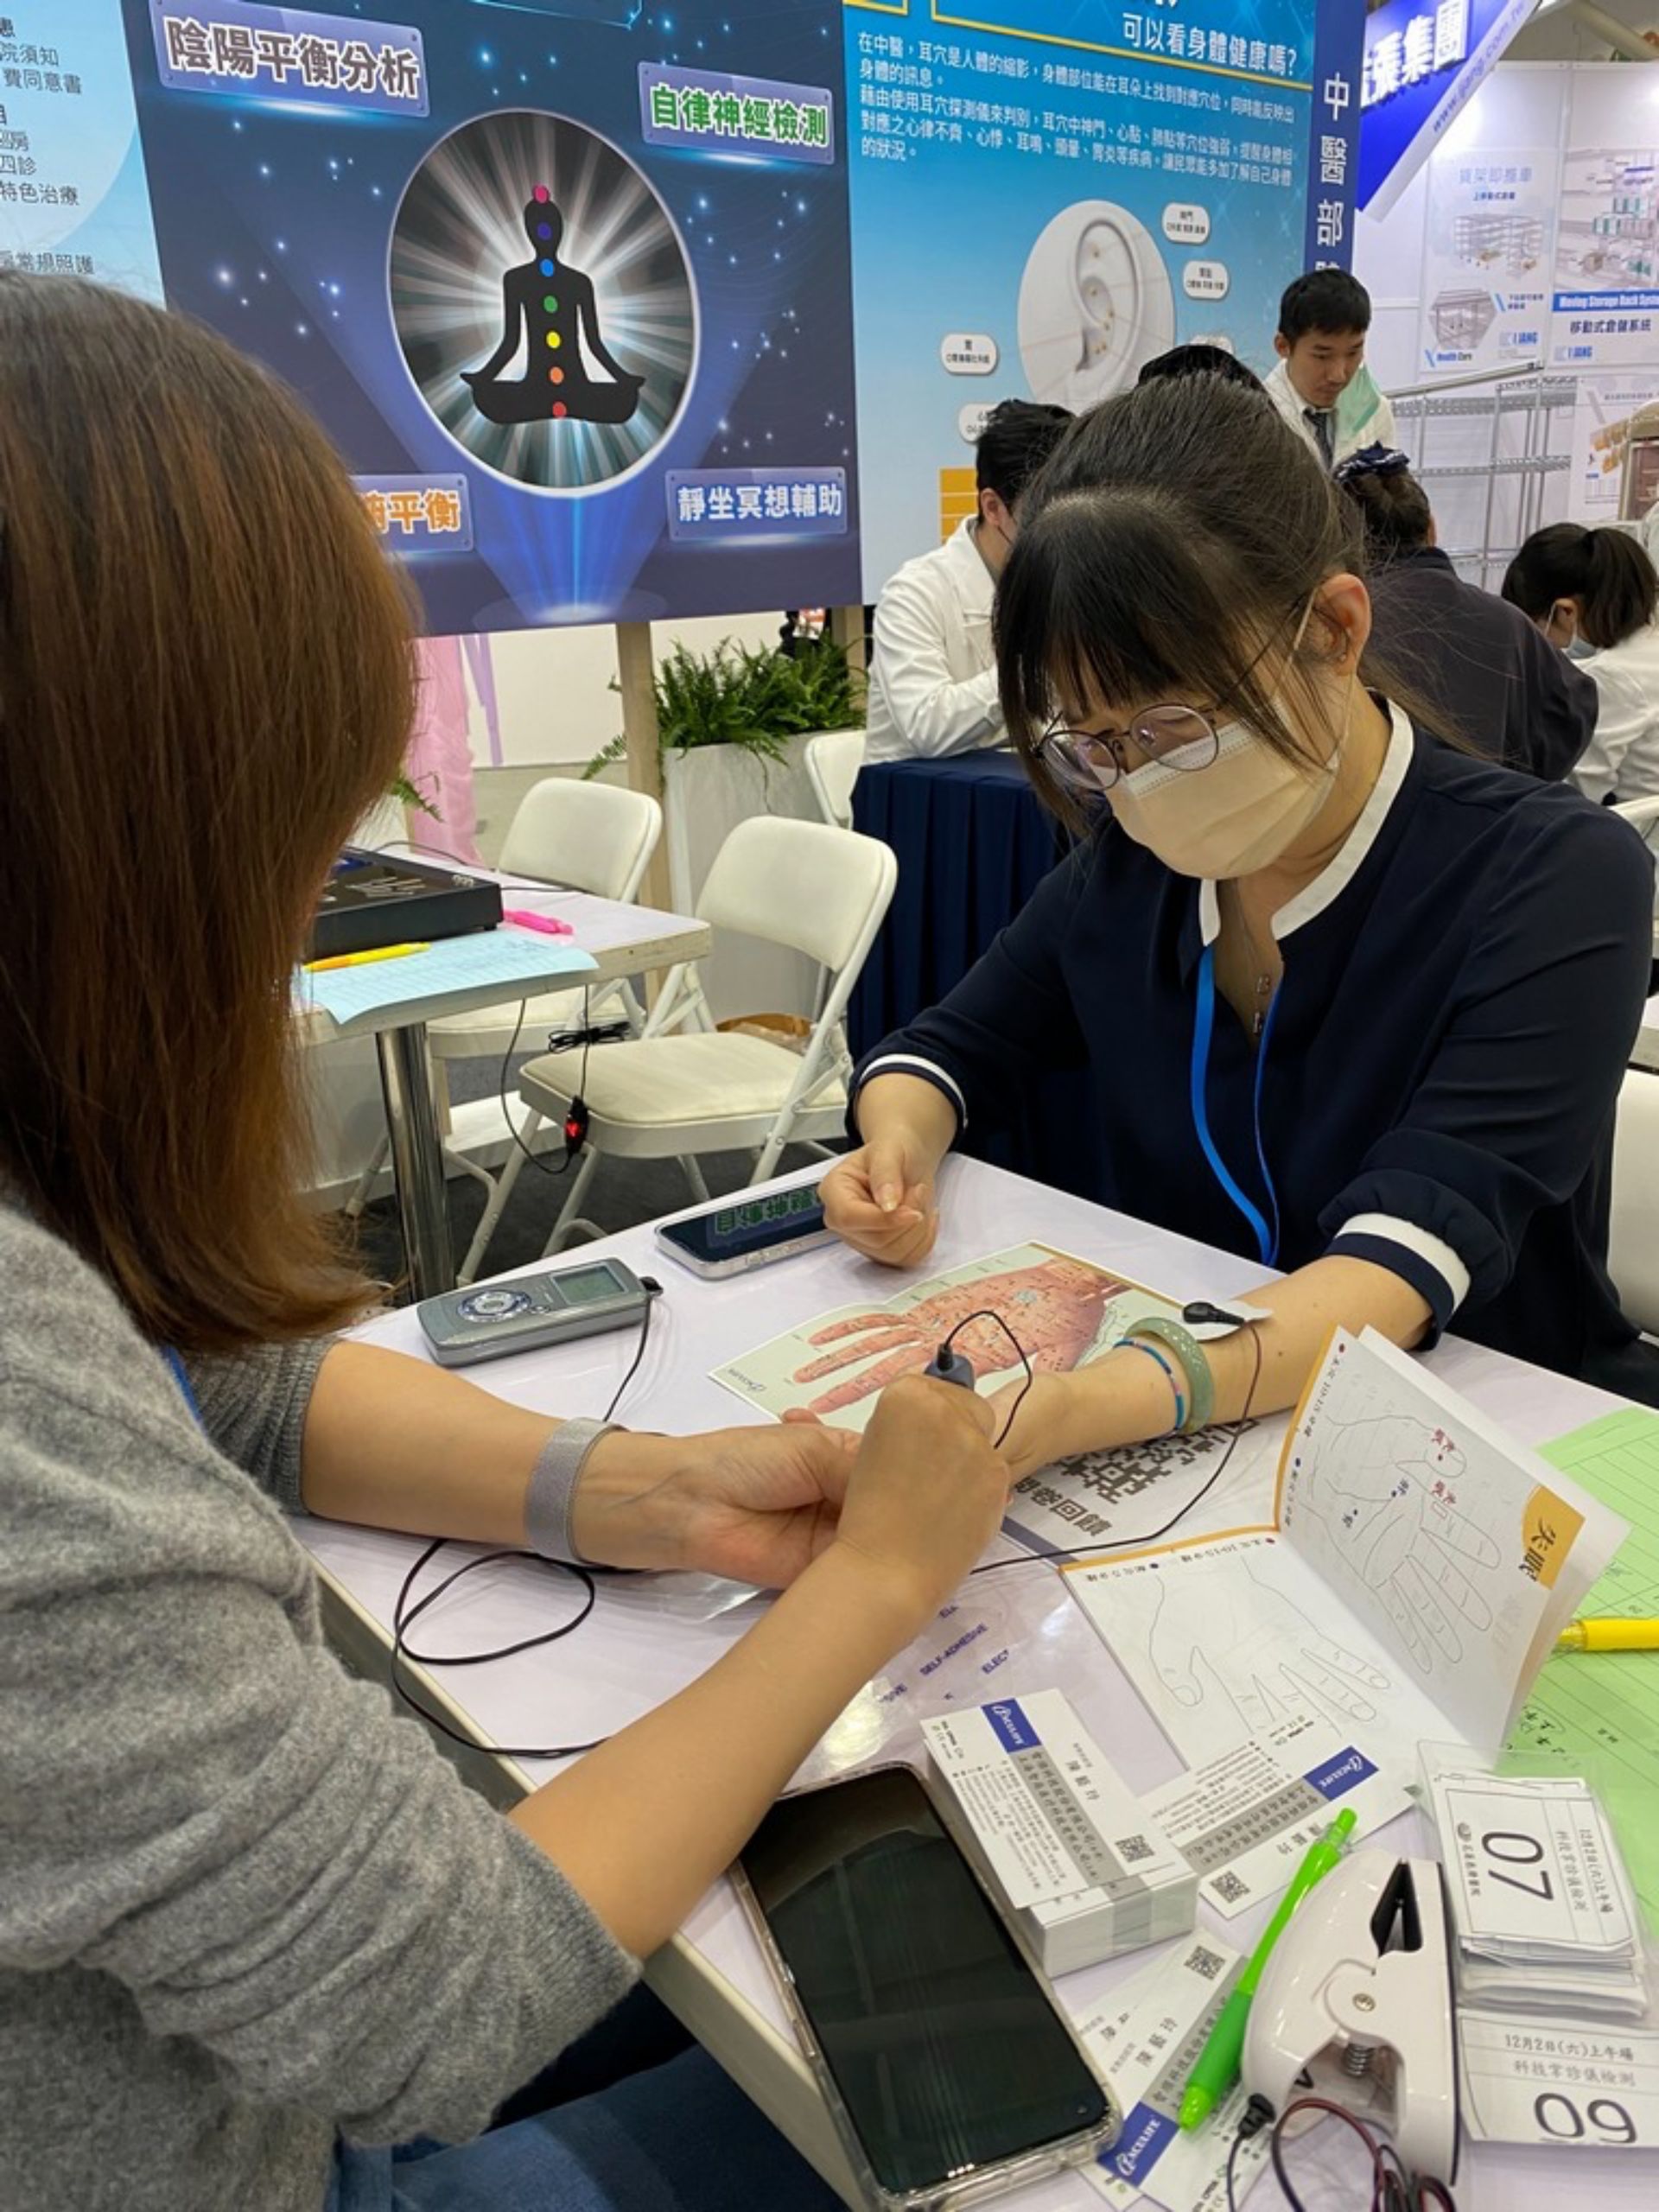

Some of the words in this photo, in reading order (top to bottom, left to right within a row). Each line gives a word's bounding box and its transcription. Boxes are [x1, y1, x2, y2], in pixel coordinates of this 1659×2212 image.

[164, 17, 419, 99] 陰陽平衡分析
[1122, 12, 1296, 76] 可以看身體健康嗎?
[651, 81, 829, 147] 自律神經檢測
[0, 181, 79, 206] 特色治療
[677, 484, 842, 522] 靜坐冥想輔助
[1518, 1517, 1557, 1582] 失眠
[919, 1624, 988, 1675] SELF-ADHESIVE
[1481, 1831, 1554, 1901] 07
[1505, 2034, 1634, 2062] 12月2日(六)上午場
[1534, 2092, 1638, 2145] 09
